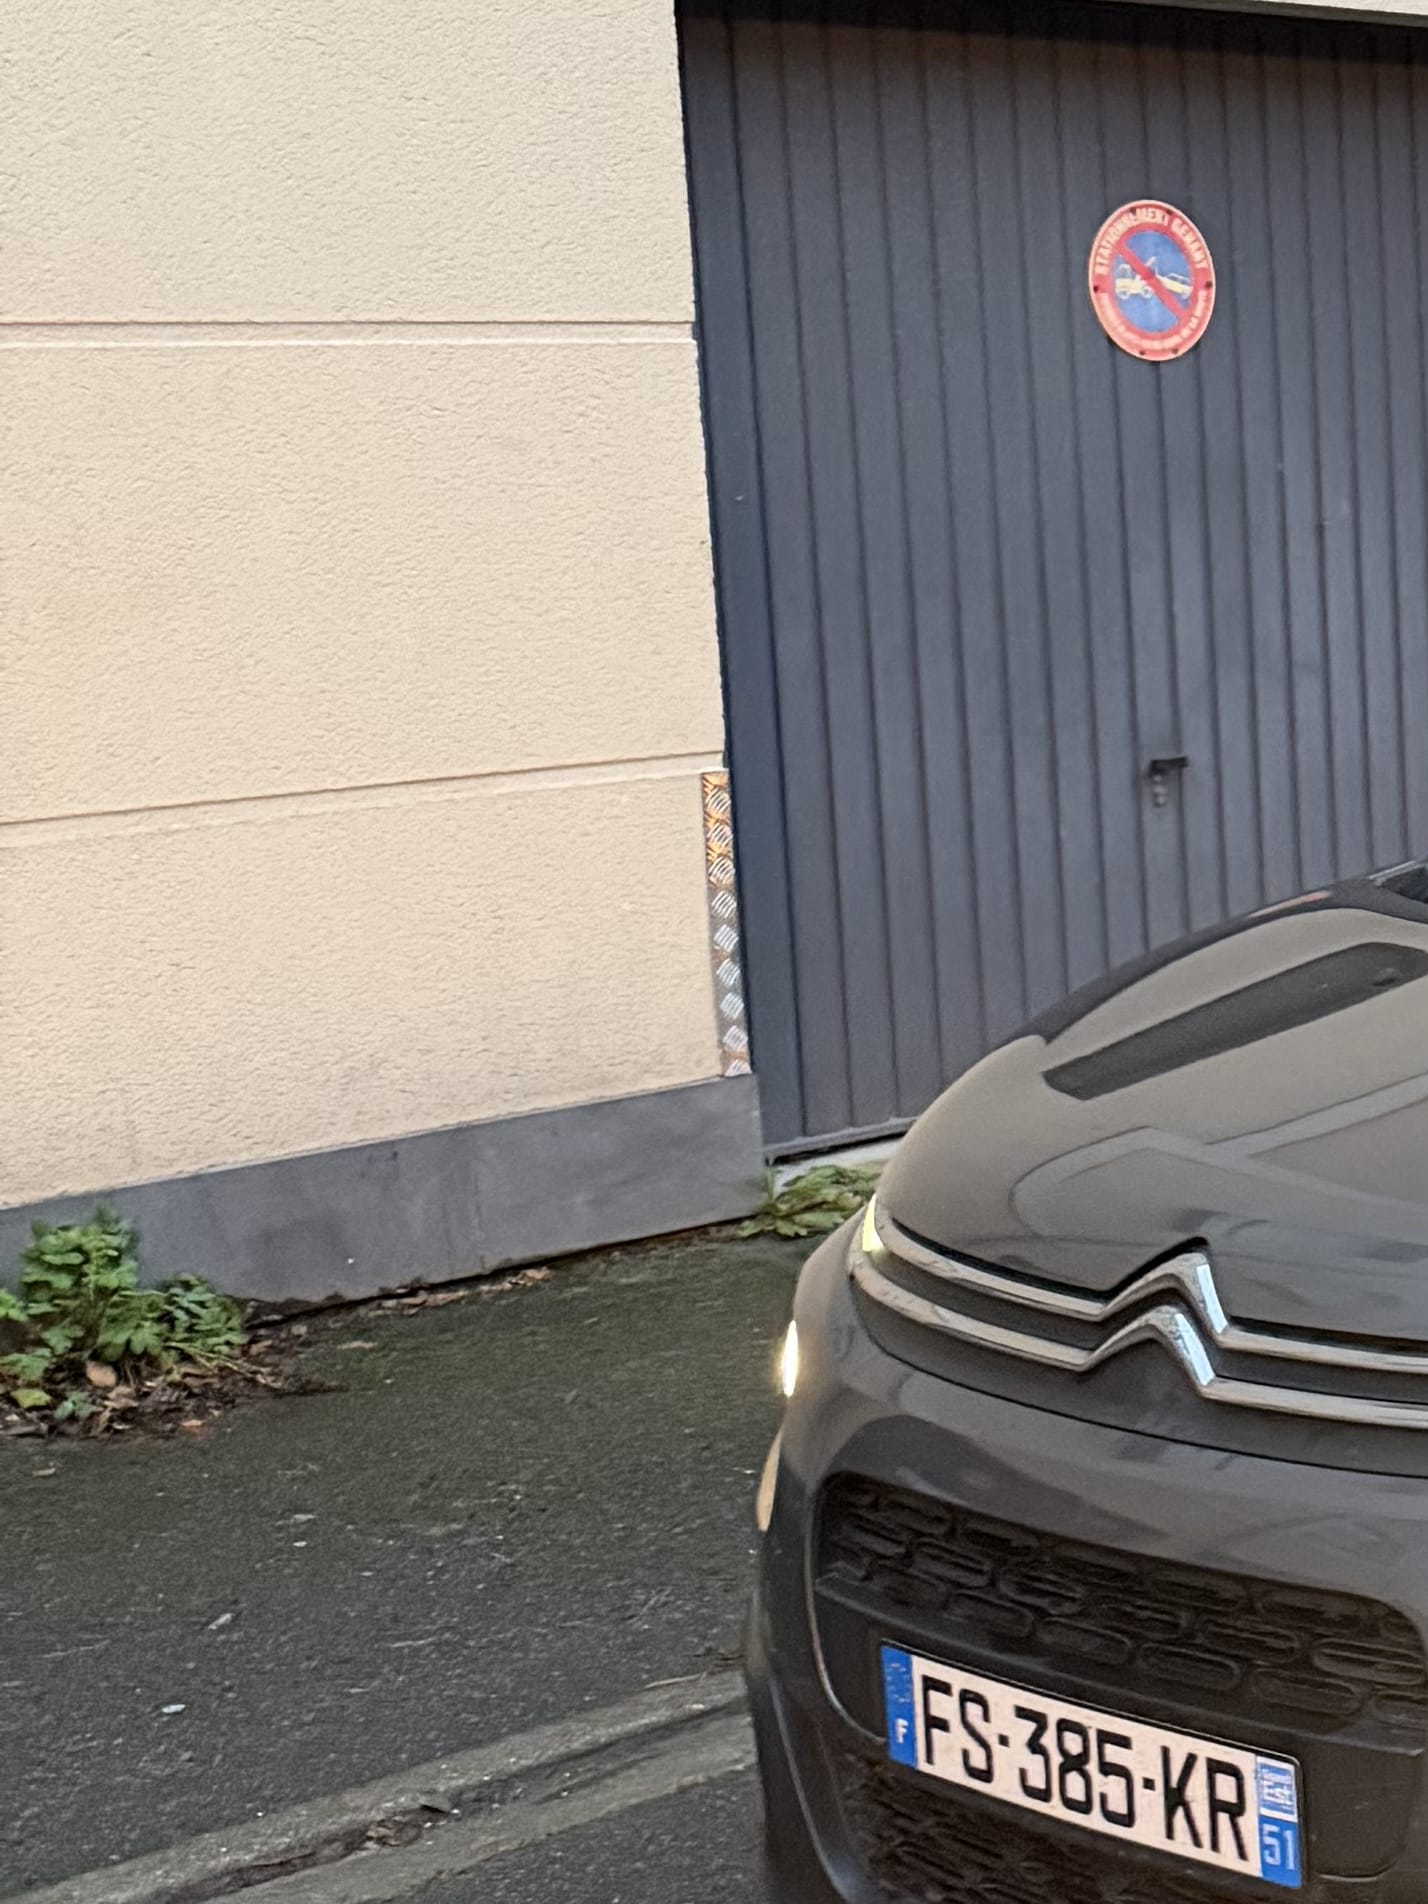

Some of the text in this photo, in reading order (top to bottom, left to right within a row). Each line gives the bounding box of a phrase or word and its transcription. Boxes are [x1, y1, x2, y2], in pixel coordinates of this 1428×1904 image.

[894, 1717, 910, 1744] F
[921, 1673, 1249, 1862] FS-385-KR
[1262, 1823, 1296, 1871] 51
